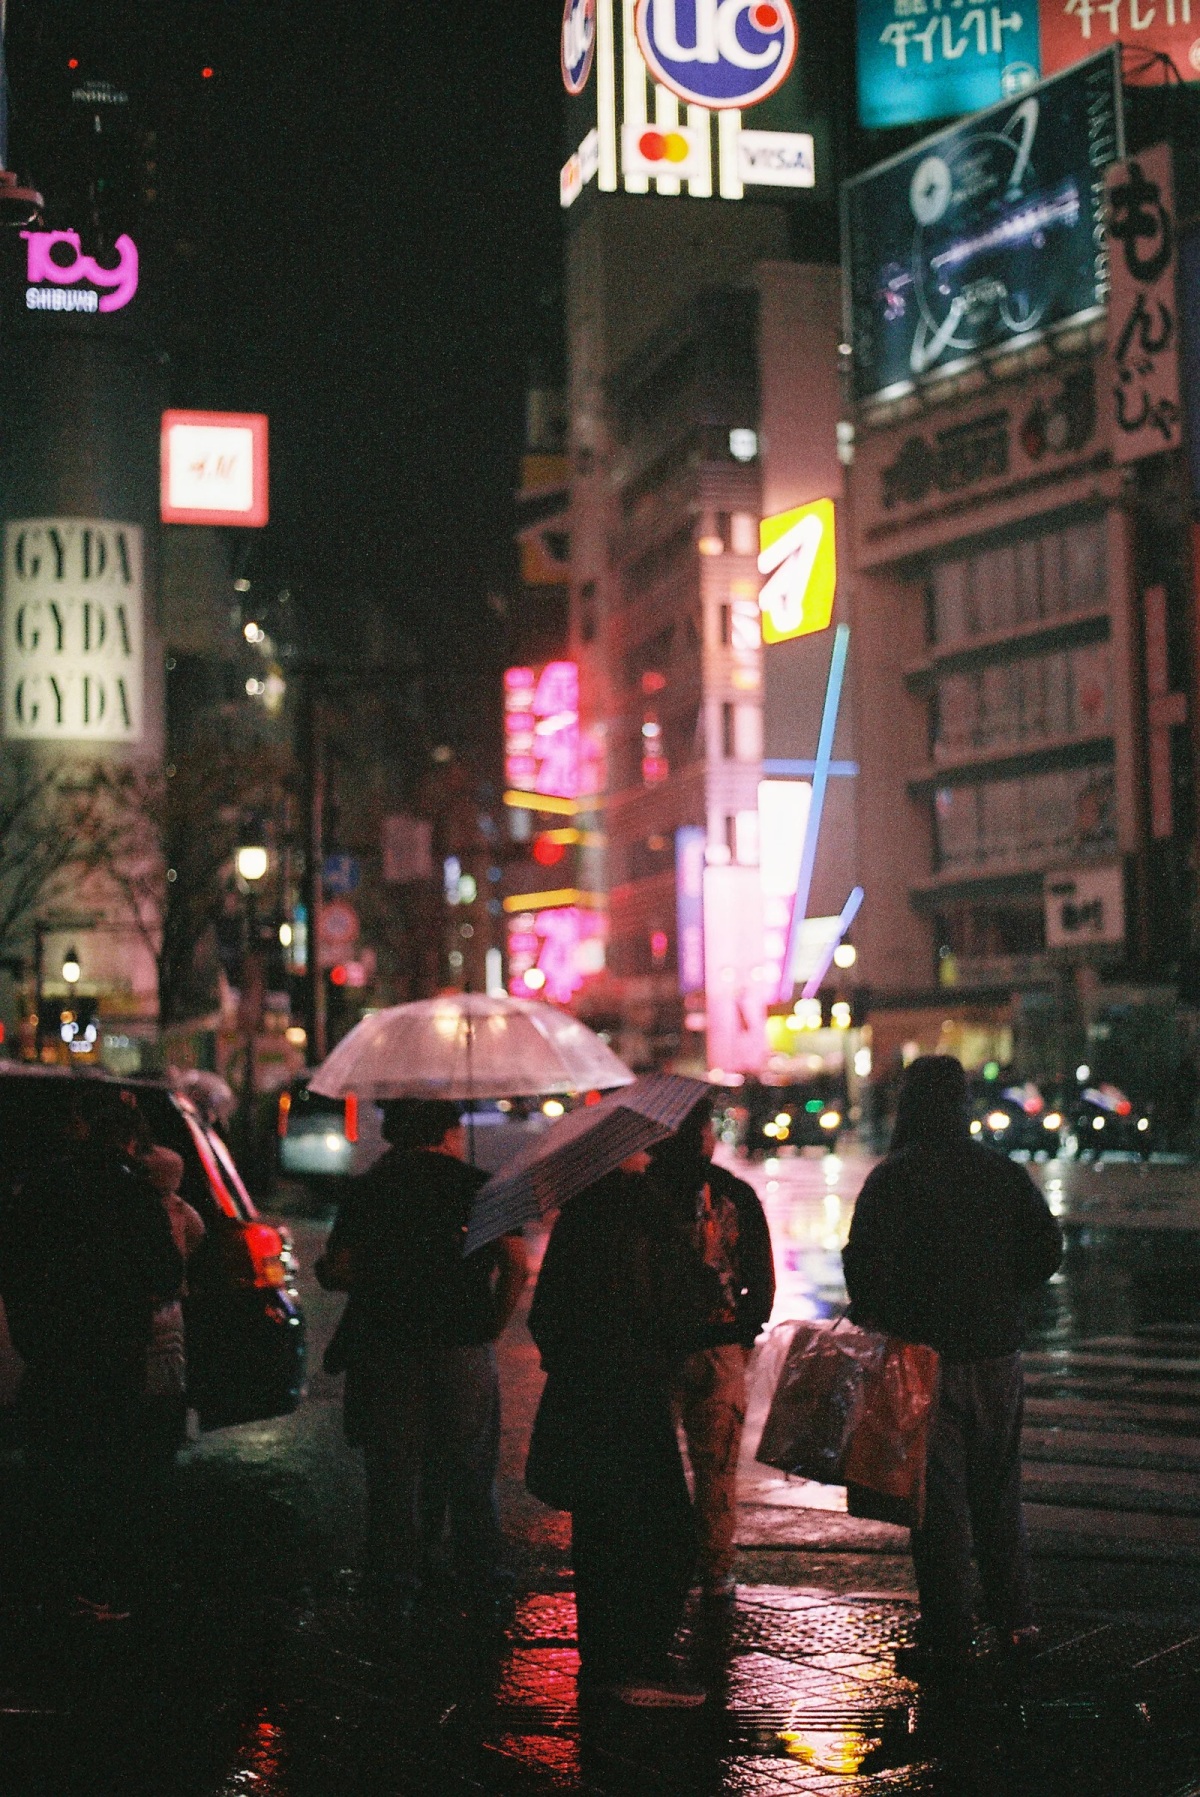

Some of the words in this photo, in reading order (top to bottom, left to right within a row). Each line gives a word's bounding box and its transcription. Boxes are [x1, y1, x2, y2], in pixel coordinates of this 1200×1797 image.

[743, 146, 812, 170] VISA
[26, 287, 98, 313] SHIBUYA
[14, 527, 132, 585] GYDA
[14, 600, 132, 656] GYDA
[14, 673, 131, 729] GYDA
